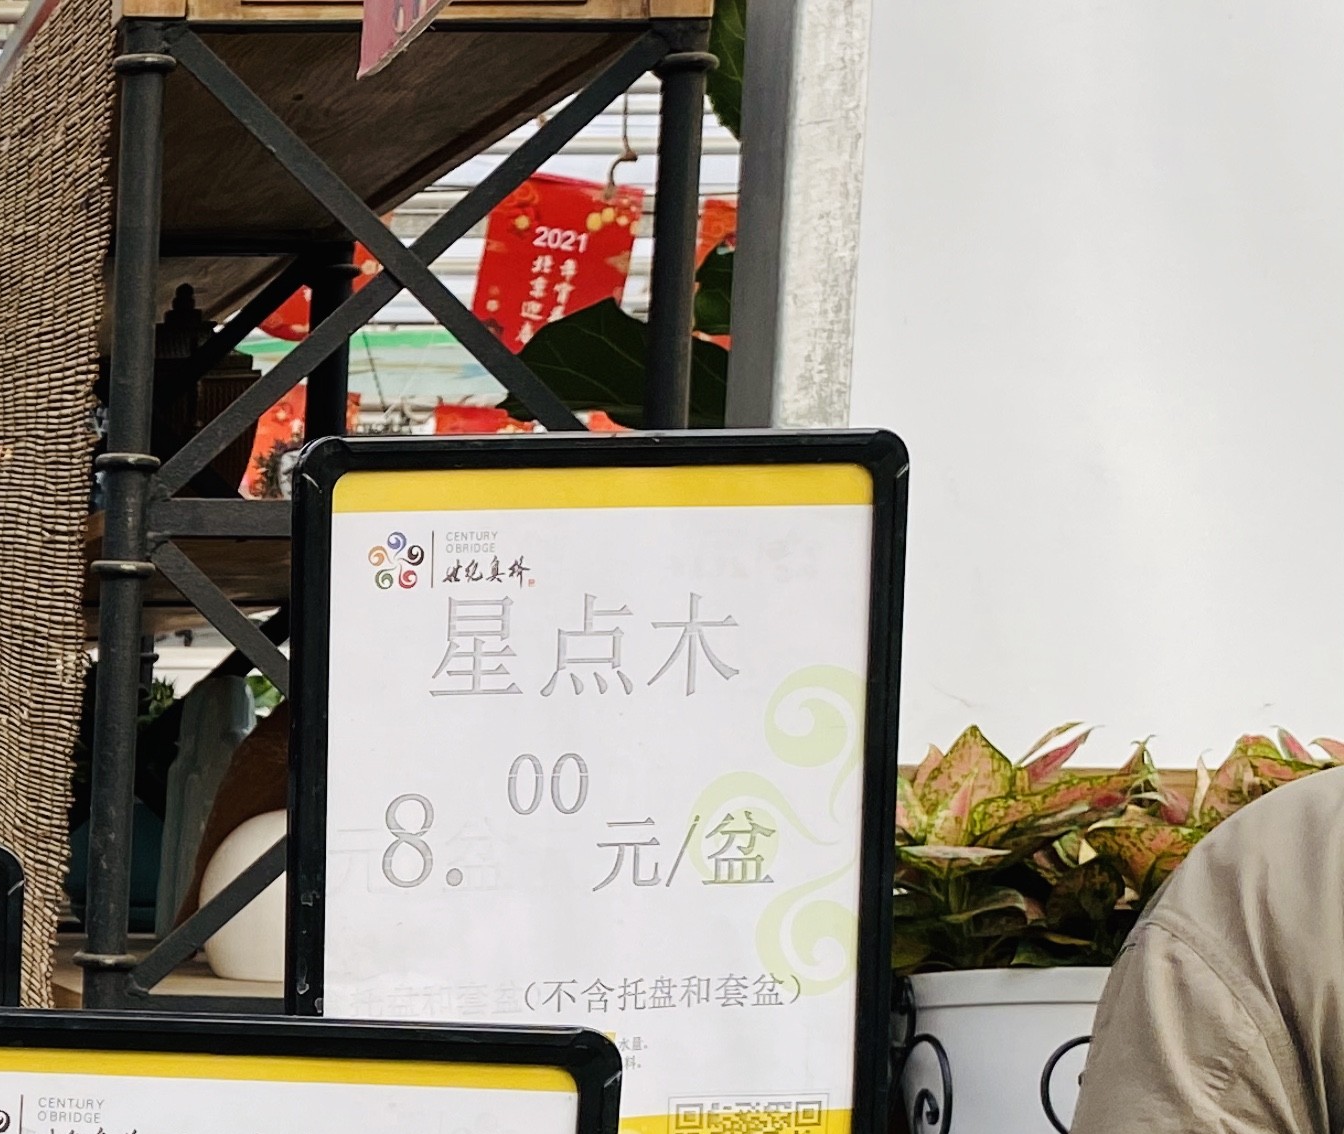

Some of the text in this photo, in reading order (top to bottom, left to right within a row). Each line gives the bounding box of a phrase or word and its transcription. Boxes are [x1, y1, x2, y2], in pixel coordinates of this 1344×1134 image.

[532, 226, 589, 253] 2021
[446, 531, 498, 541] CENTURY
[429, 592, 740, 698] 星点木
[507, 753, 589, 816] 00
[592, 810, 777, 892] 元/盆
[37, 1097, 105, 1110] CENTURY
